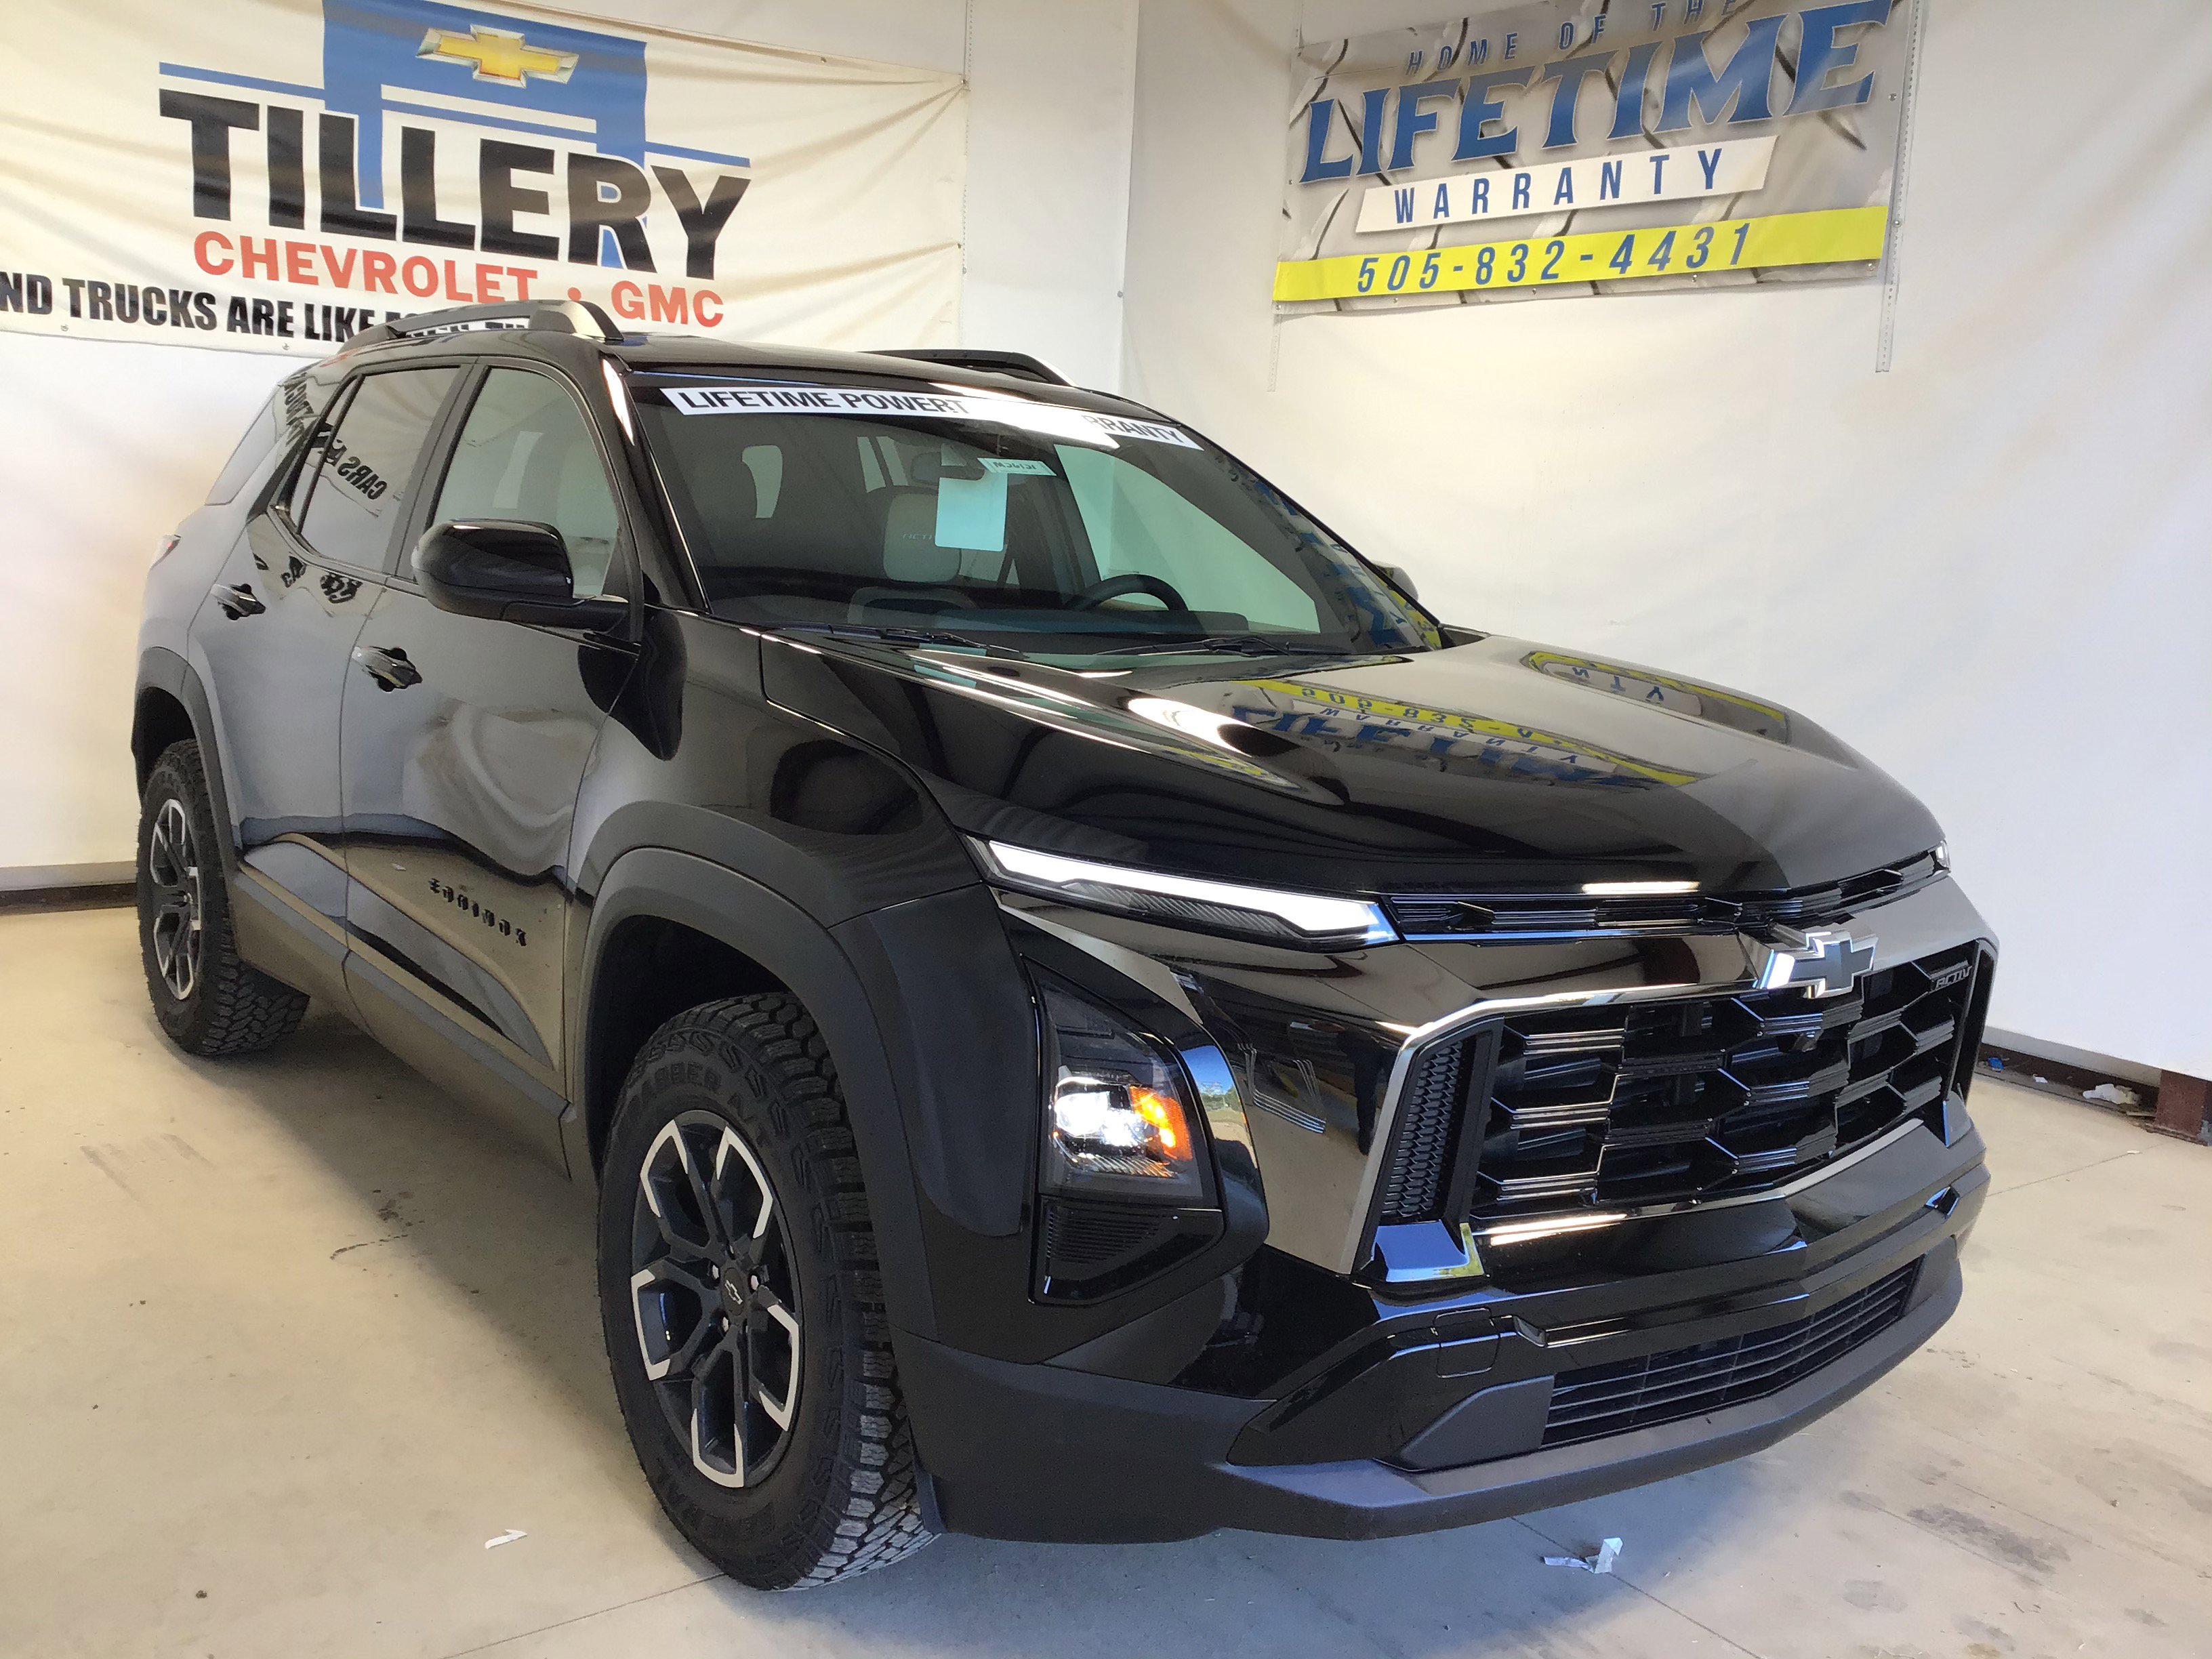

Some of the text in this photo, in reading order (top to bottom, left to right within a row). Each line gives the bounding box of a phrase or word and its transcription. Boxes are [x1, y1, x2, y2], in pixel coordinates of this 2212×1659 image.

[1406, 32, 1518, 75] HOME
[1559, 14, 1607, 51] OF
[1298, 0, 1893, 185] LIFETIME
[159, 88, 752, 281] TILLERY
[1393, 148, 1724, 224] WARRANTY
[194, 231, 724, 327] CHEVROLET GMC
[1357, 222, 1753, 294] 505-832-4431
[62, 277, 217, 331] TRUCKS
[226, 295, 294, 338] ARE
[677, 391, 1185, 443] LIFETIME POWERT RRANTY
[1936, 965, 1973, 989] ACTIV
